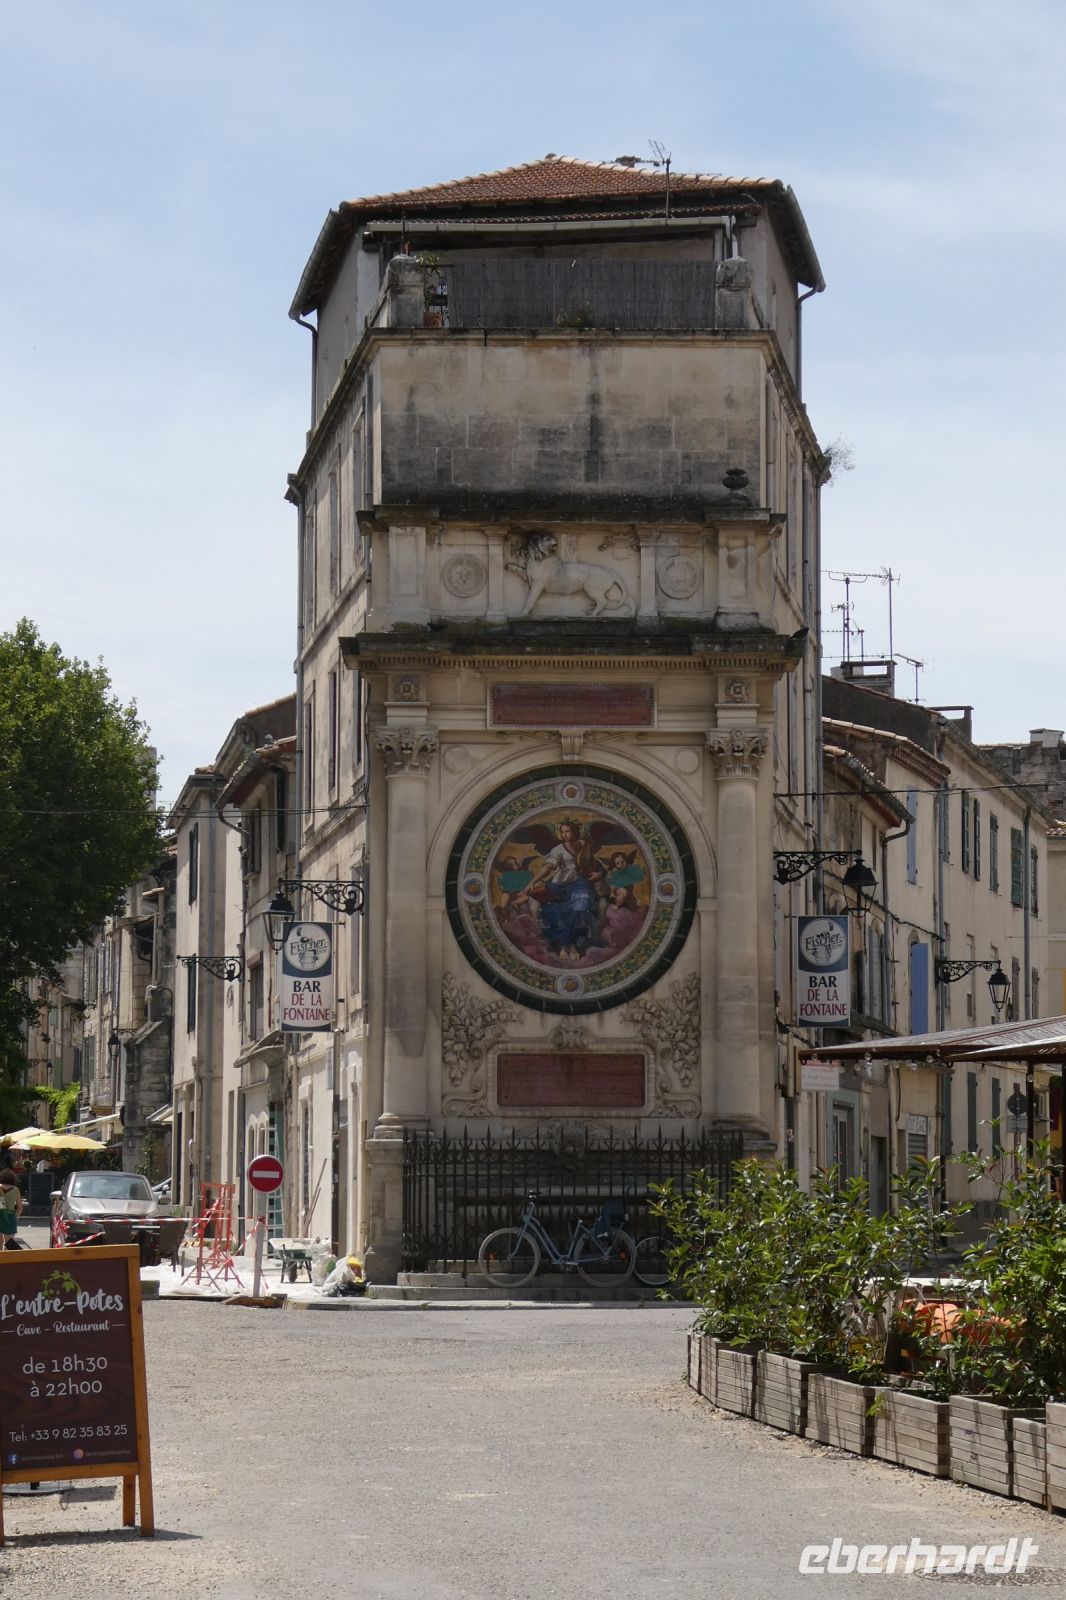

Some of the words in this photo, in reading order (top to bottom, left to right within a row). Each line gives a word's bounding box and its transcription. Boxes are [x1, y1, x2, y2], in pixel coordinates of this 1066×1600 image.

[293, 981, 321, 993] BAR
[809, 976, 837, 988] BAR
[292, 994, 304, 1006] DE
[311, 994, 322, 1006] LA
[808, 989, 820, 1001] DE
[827, 989, 839, 1001] LA
[283, 1008, 330, 1020] FONTAINE
[800, 1003, 847, 1016] FONTAINE
[0, 1288, 124, 1320] L'entre-Potes
[16, 1324, 42, 1336] Cave
[53, 1320, 110, 1333] Restaurant
[22, 1356, 46, 1374] de
[51, 1353, 108, 1372] 18h30
[30, 1380, 40, 1397] à
[46, 1377, 103, 1396] 22h00
[30, 1430, 49, 1441] +33
[52, 1429, 60, 1439] 9
[62, 1428, 77, 1438] 82
[79, 1426, 94, 1438] 35
[96, 1425, 111, 1437] 83
[113, 1424, 128, 1436] 25
